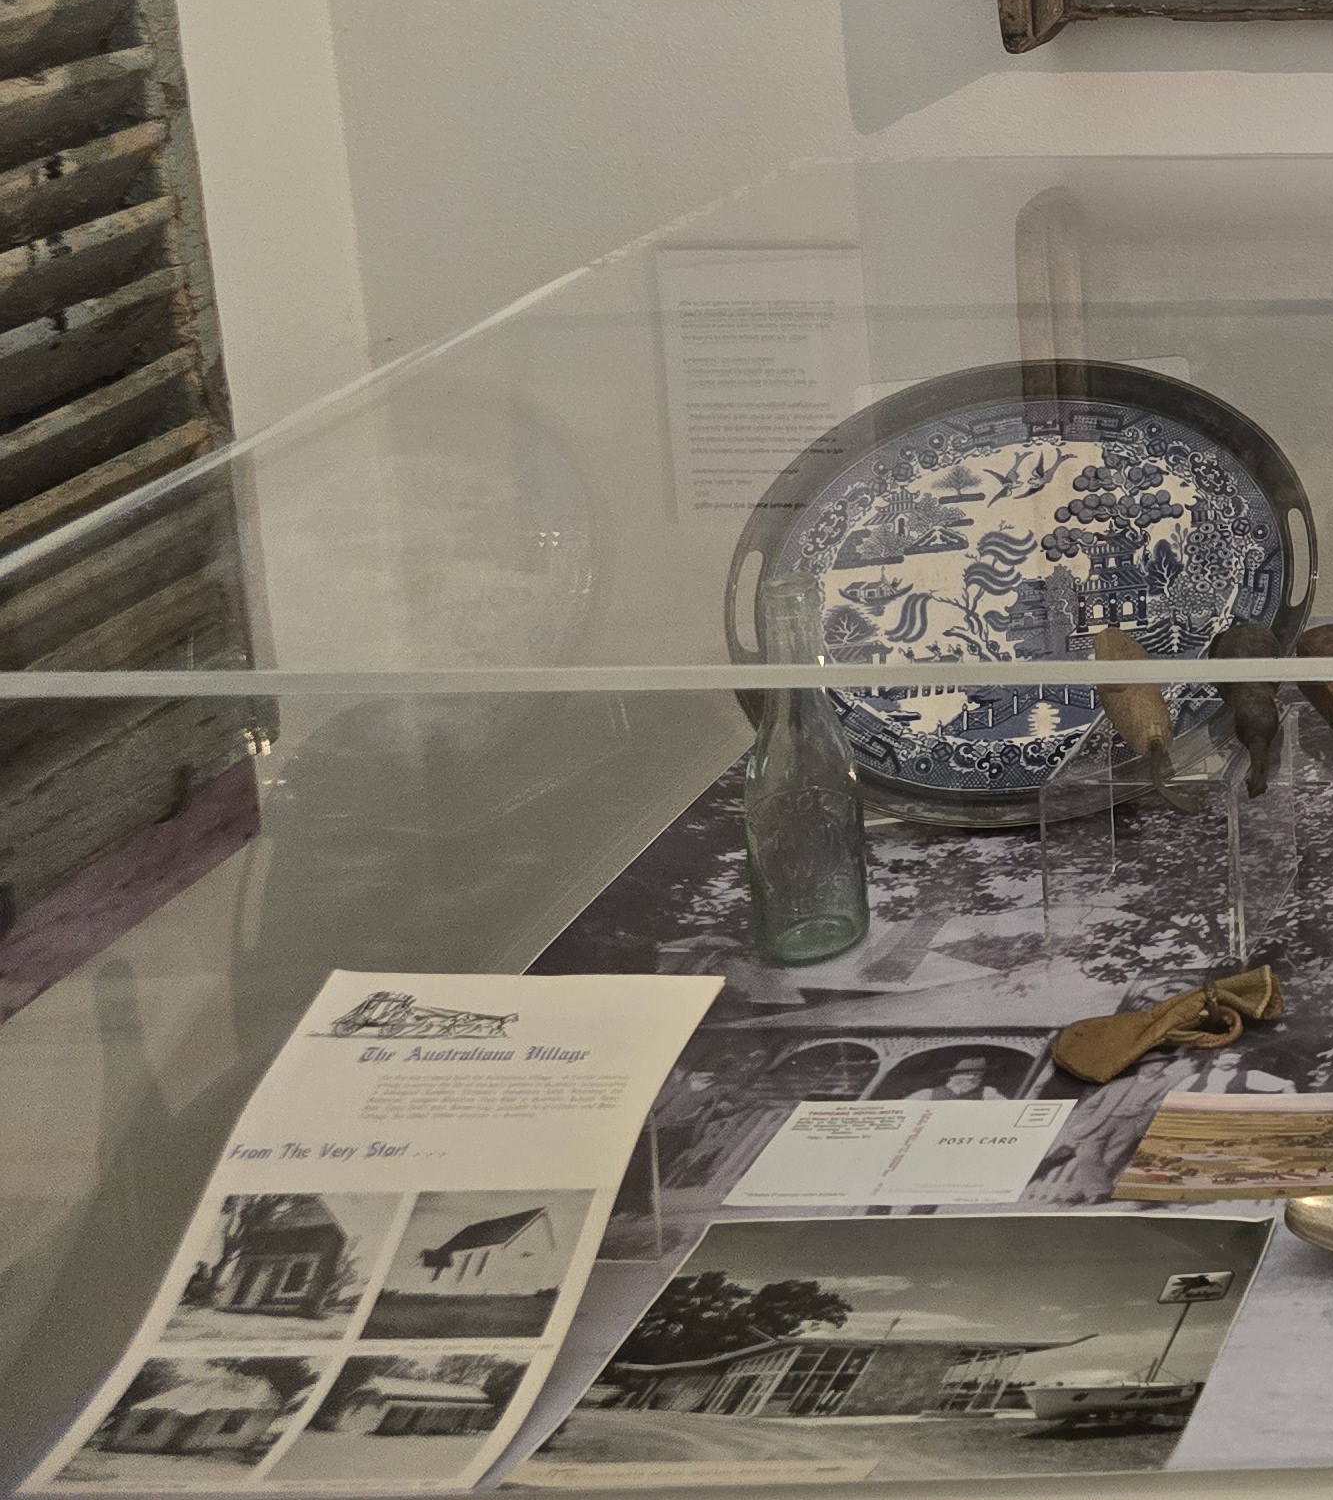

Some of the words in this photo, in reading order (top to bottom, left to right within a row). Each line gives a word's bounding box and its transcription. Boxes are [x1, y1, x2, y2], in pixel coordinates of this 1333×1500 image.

[357, 1046, 394, 1063] The
[403, 1046, 514, 1062] Australiana
[525, 1045, 591, 1063] Village
[938, 1136, 974, 1146] POST
[978, 1136, 1018, 1145] CARD
[229, 1144, 272, 1160] From
[278, 1142, 311, 1159] The
[319, 1142, 359, 1161] Very
